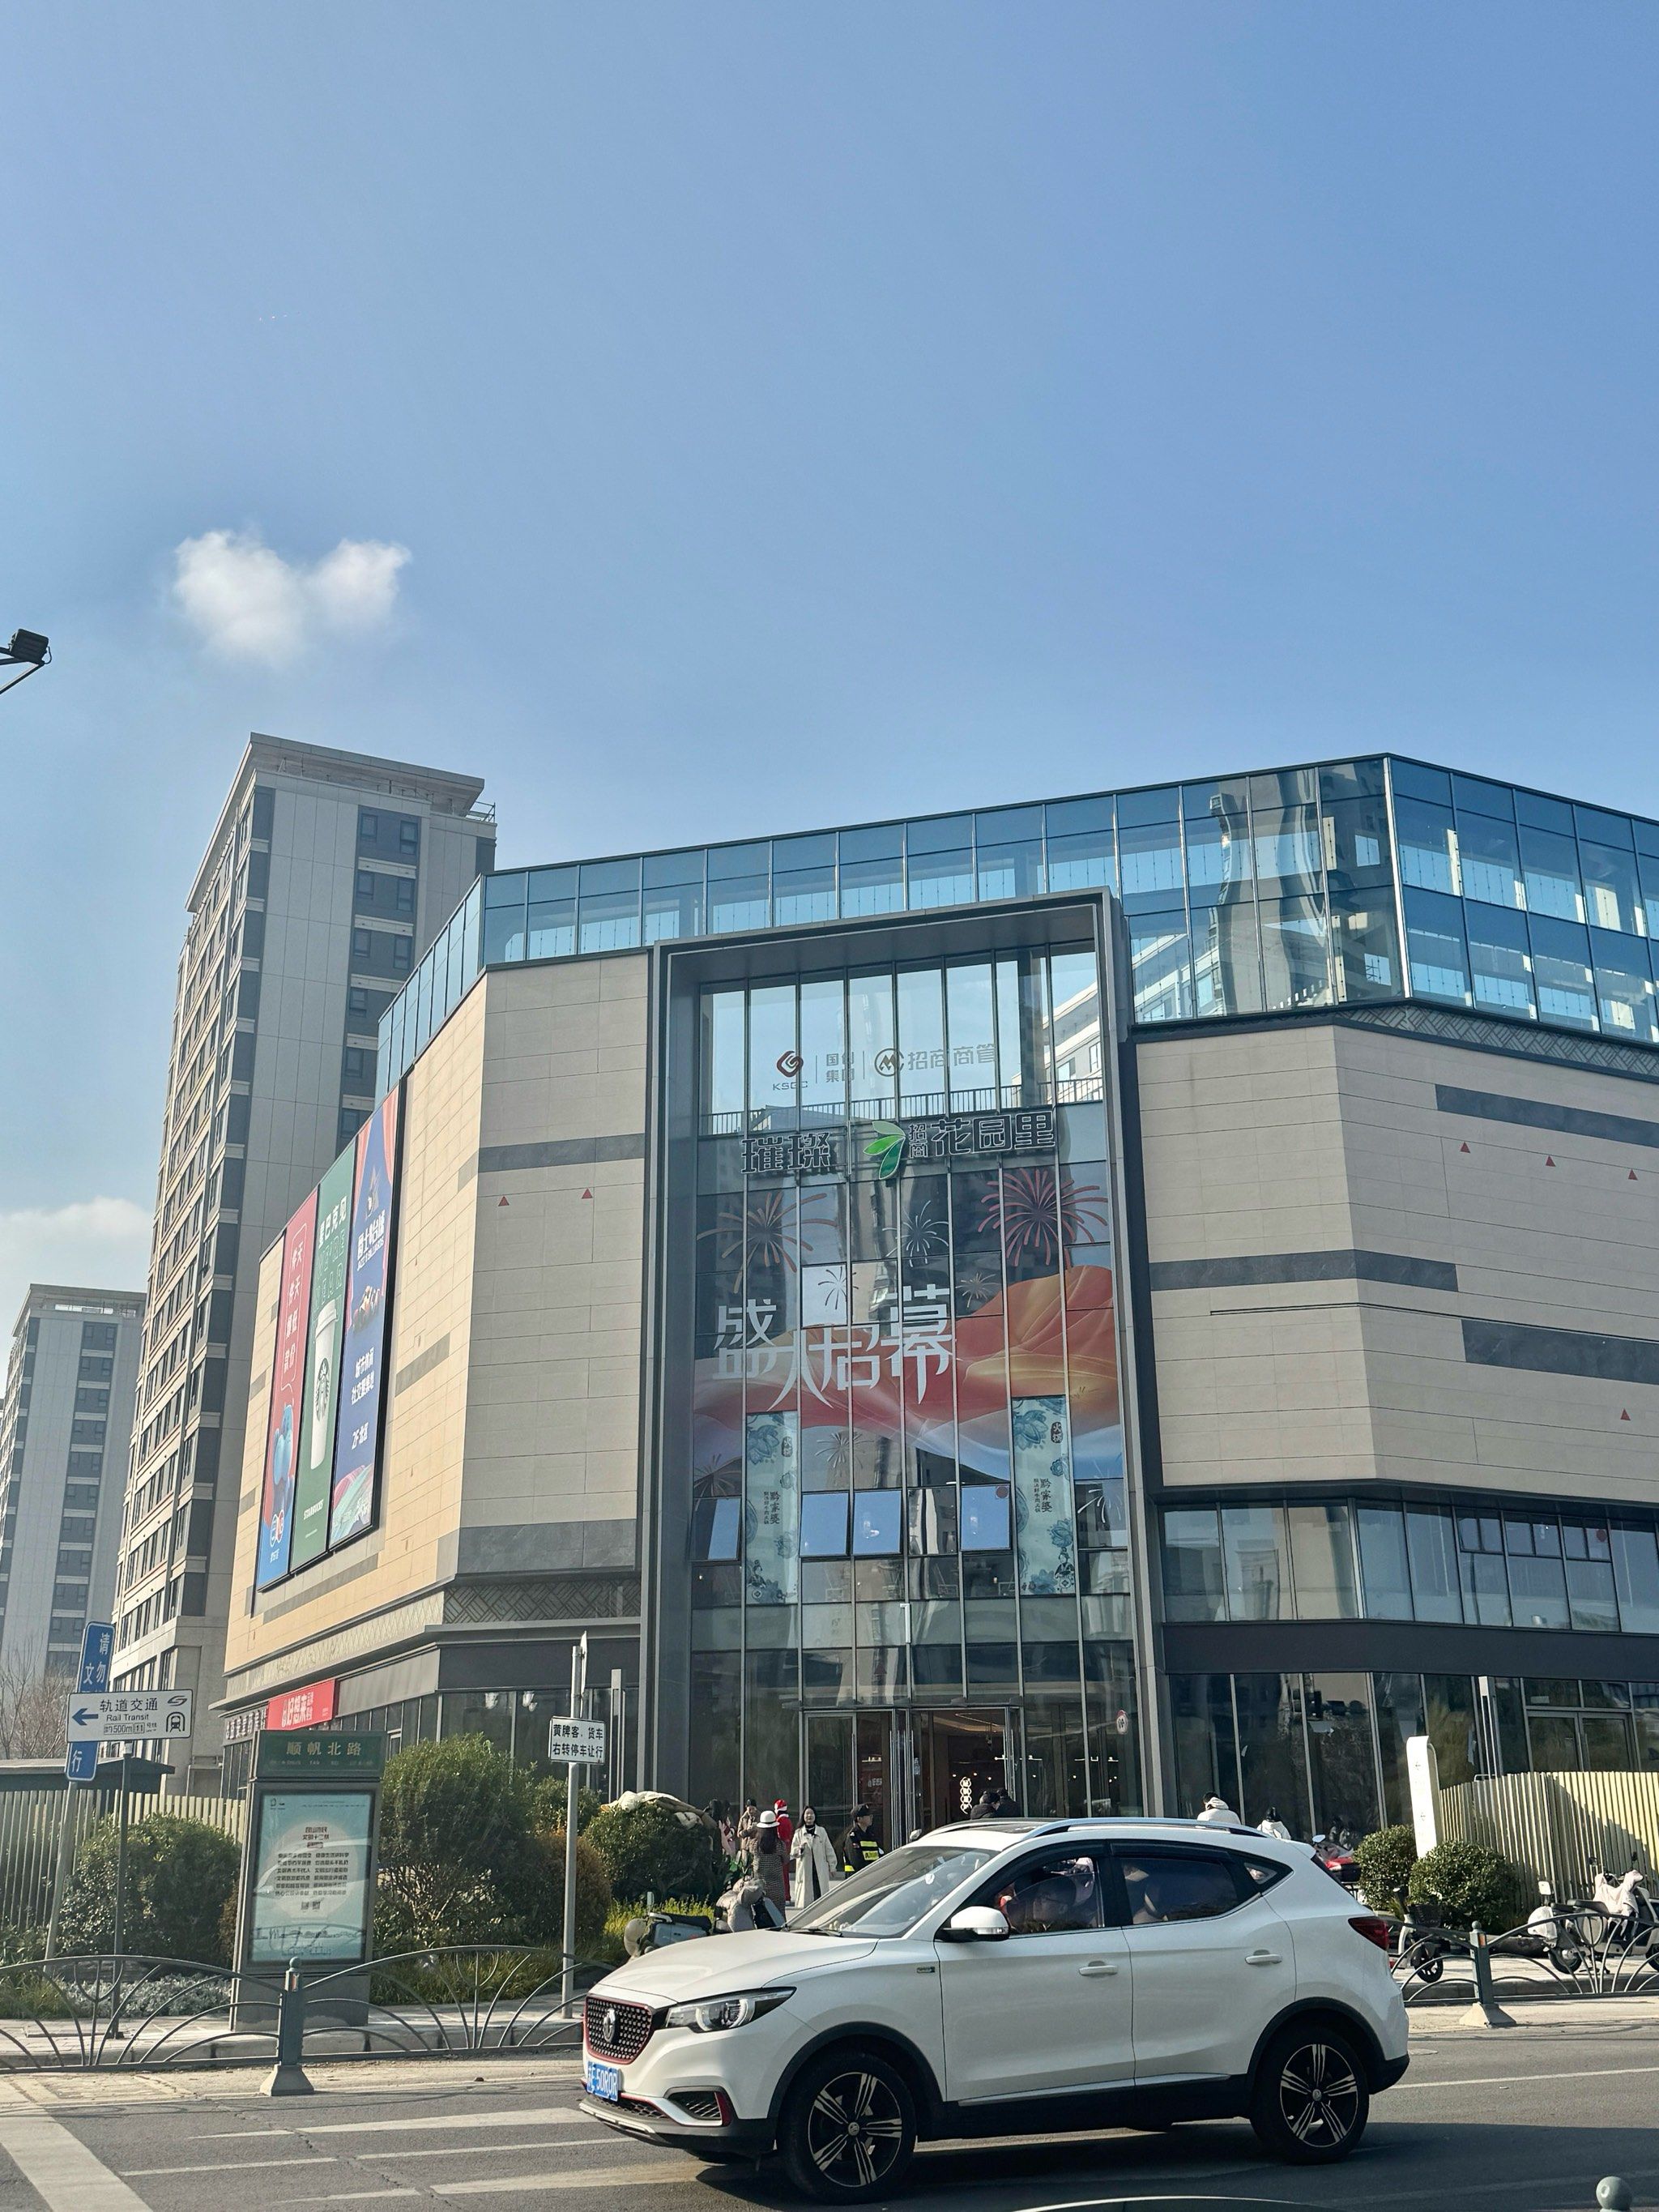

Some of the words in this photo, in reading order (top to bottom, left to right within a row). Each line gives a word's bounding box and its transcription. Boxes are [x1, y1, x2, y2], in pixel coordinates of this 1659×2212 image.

[907, 1044, 996, 1070] 招商商管
[930, 1110, 1056, 1156] 花园里
[741, 1132, 831, 1174] 璀璨
[713, 1283, 963, 1412] 盛大启幕
[100, 1697, 158, 1712] 轨道交通
[106, 1714, 121, 1722] Rail
[123, 1713, 149, 1721] Transit
[287, 1741, 361, 1755] 顺帆北路
[552, 1742, 603, 1758] 右转停车让行
